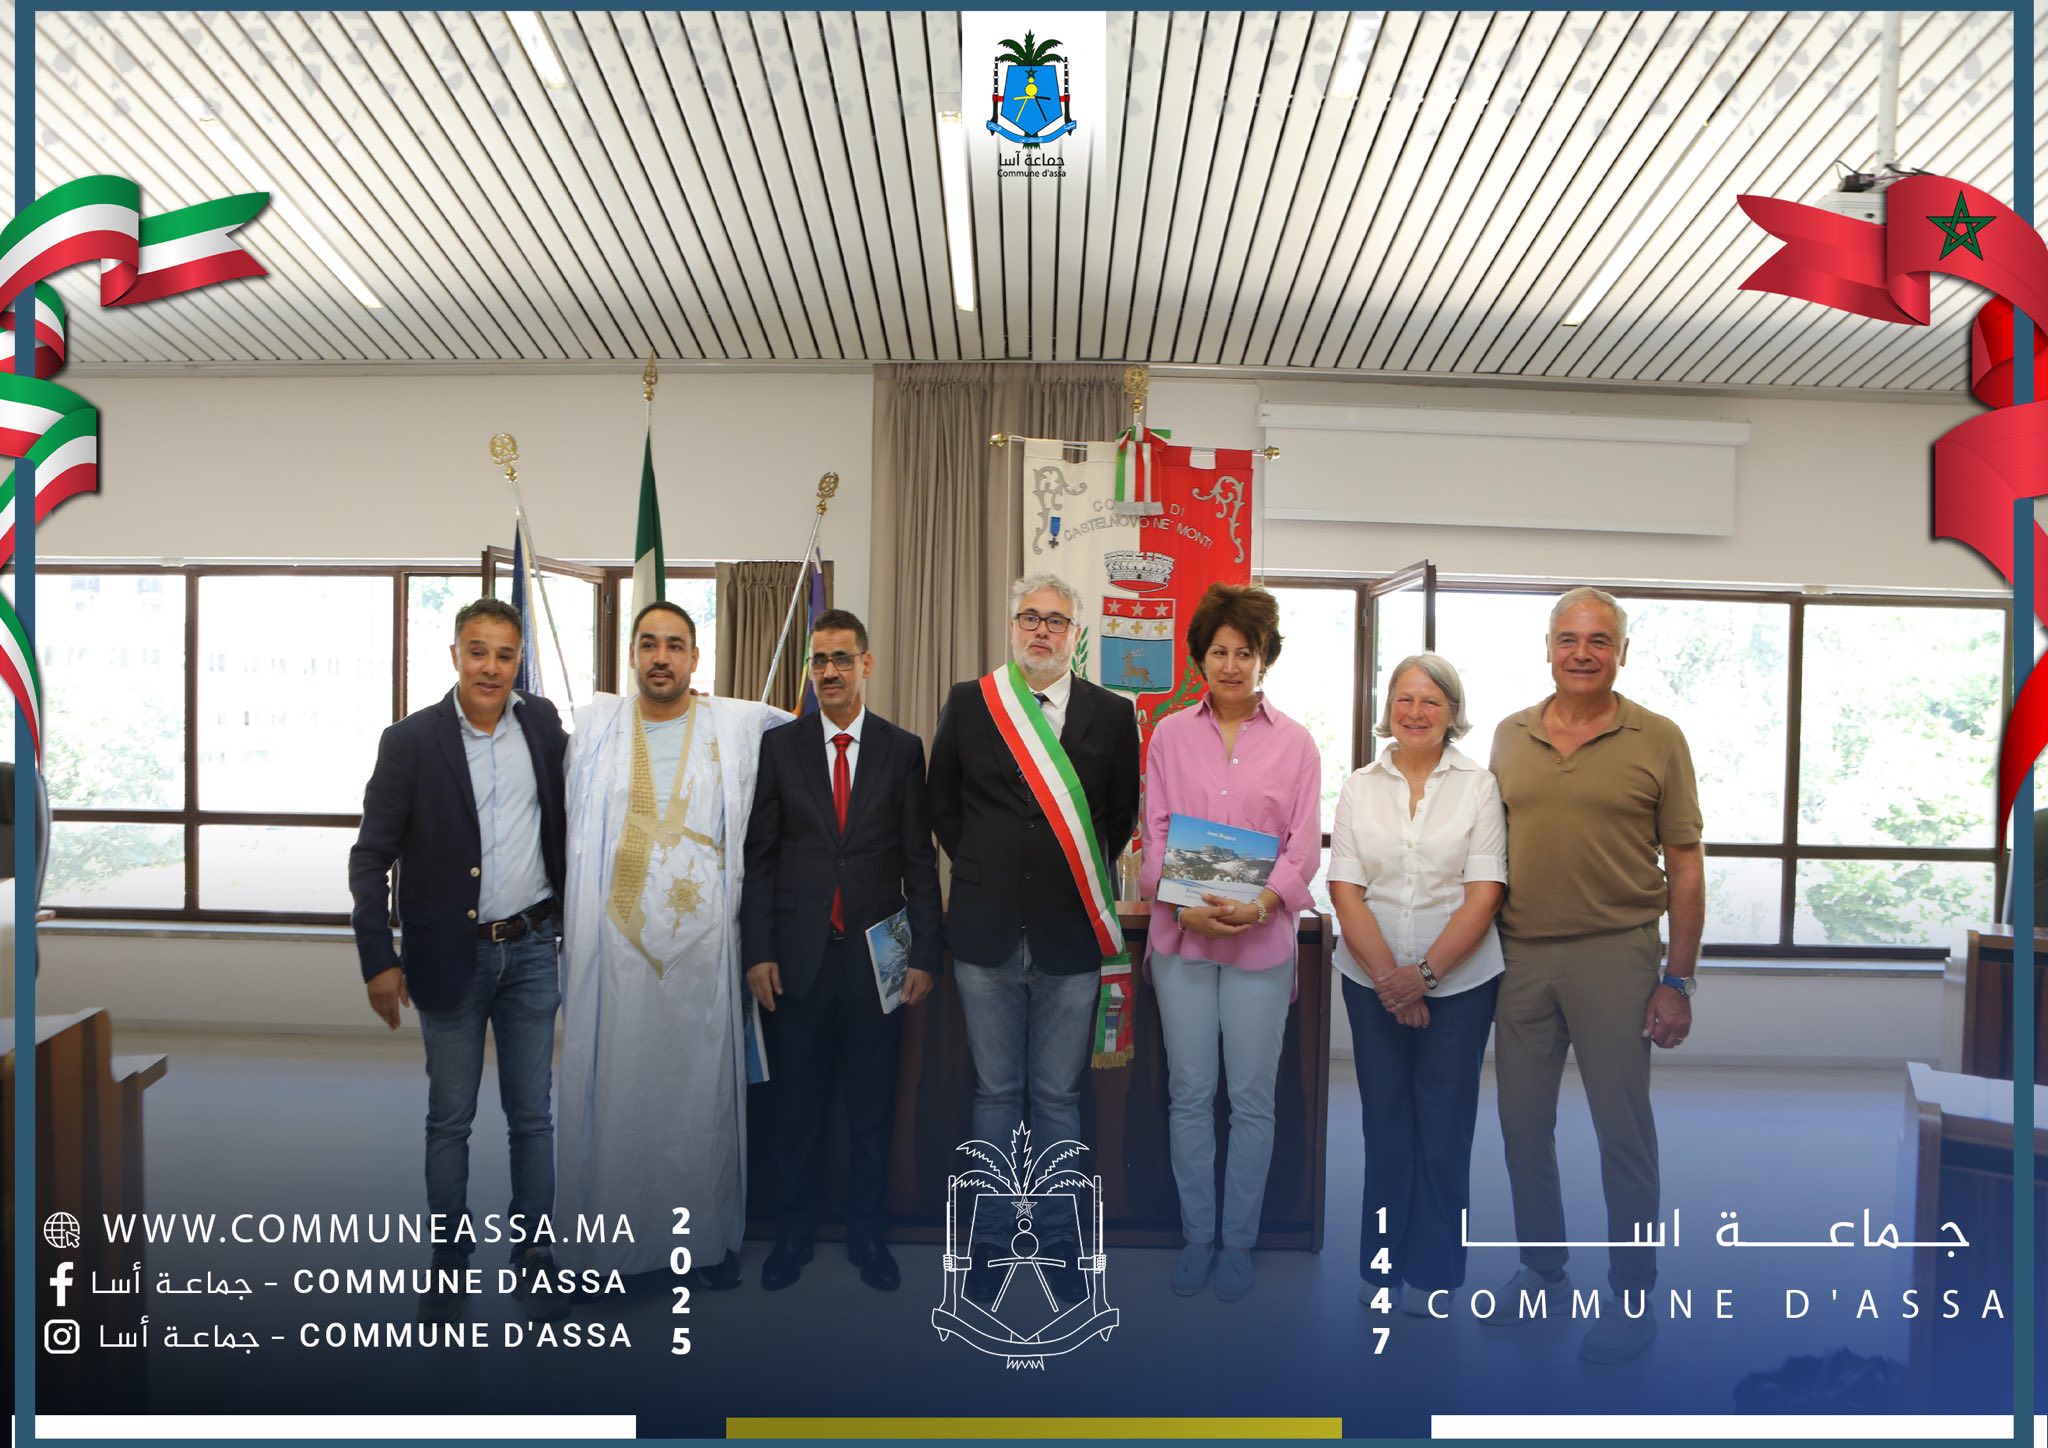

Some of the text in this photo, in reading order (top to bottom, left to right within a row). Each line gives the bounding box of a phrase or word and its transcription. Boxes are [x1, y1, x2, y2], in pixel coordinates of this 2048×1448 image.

[1169, 503, 1184, 517] DI
[1063, 515, 1150, 541] CASTELNOVO
[1176, 523, 1213, 549] MONTI
